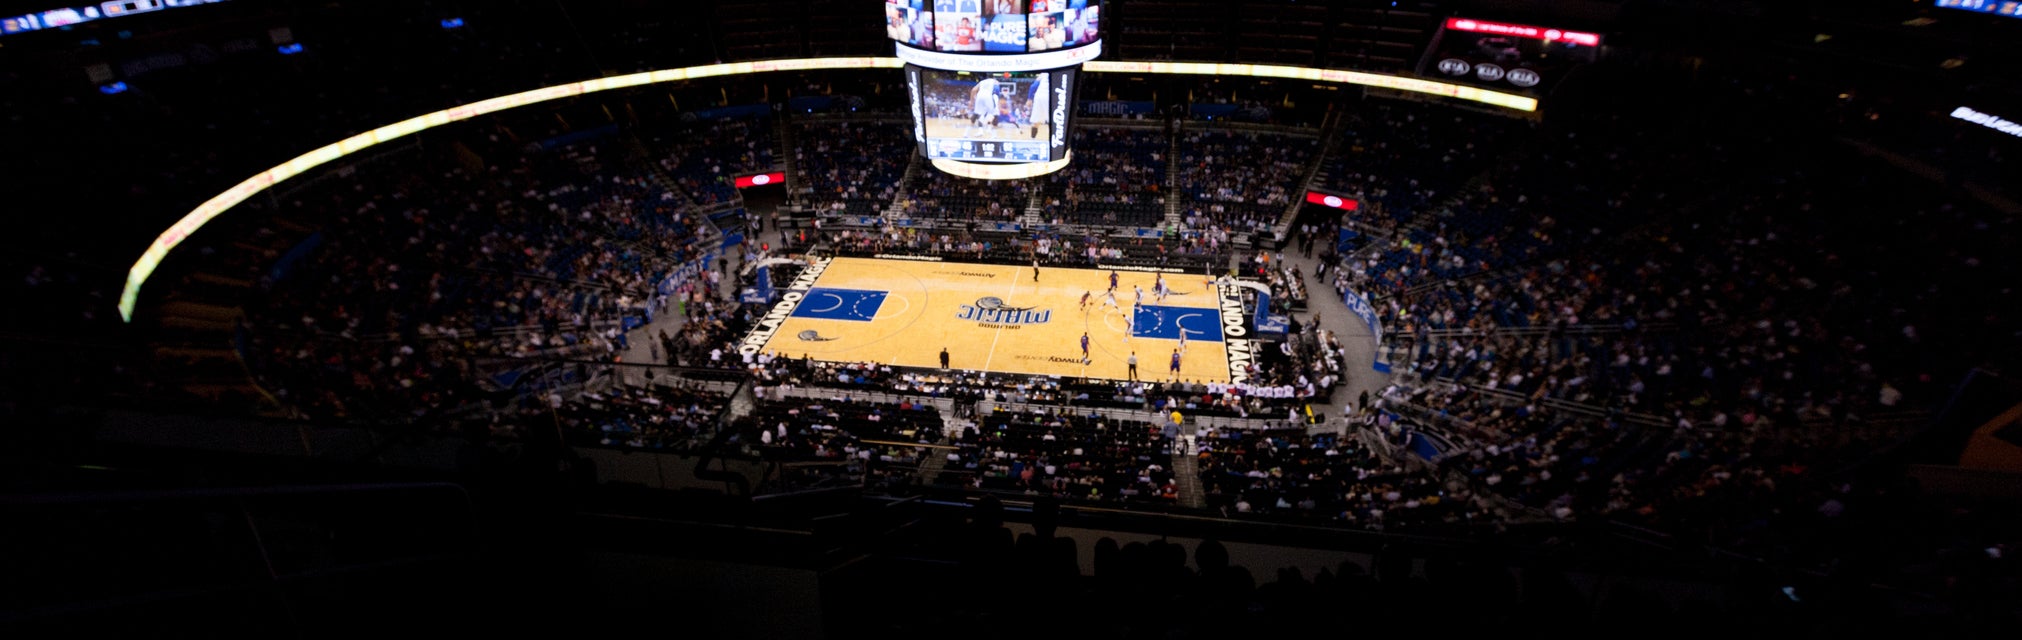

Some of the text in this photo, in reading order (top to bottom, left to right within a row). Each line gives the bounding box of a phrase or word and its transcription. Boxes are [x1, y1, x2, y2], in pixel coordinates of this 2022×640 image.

[990, 21, 1026, 33] PURE
[976, 30, 1027, 46] MAGIC
[976, 59, 1012, 67] Orlando
[955, 304, 1053, 325] MAGIC
[1347, 293, 1371, 325] PURE
[739, 292, 803, 355] ORLANDO
